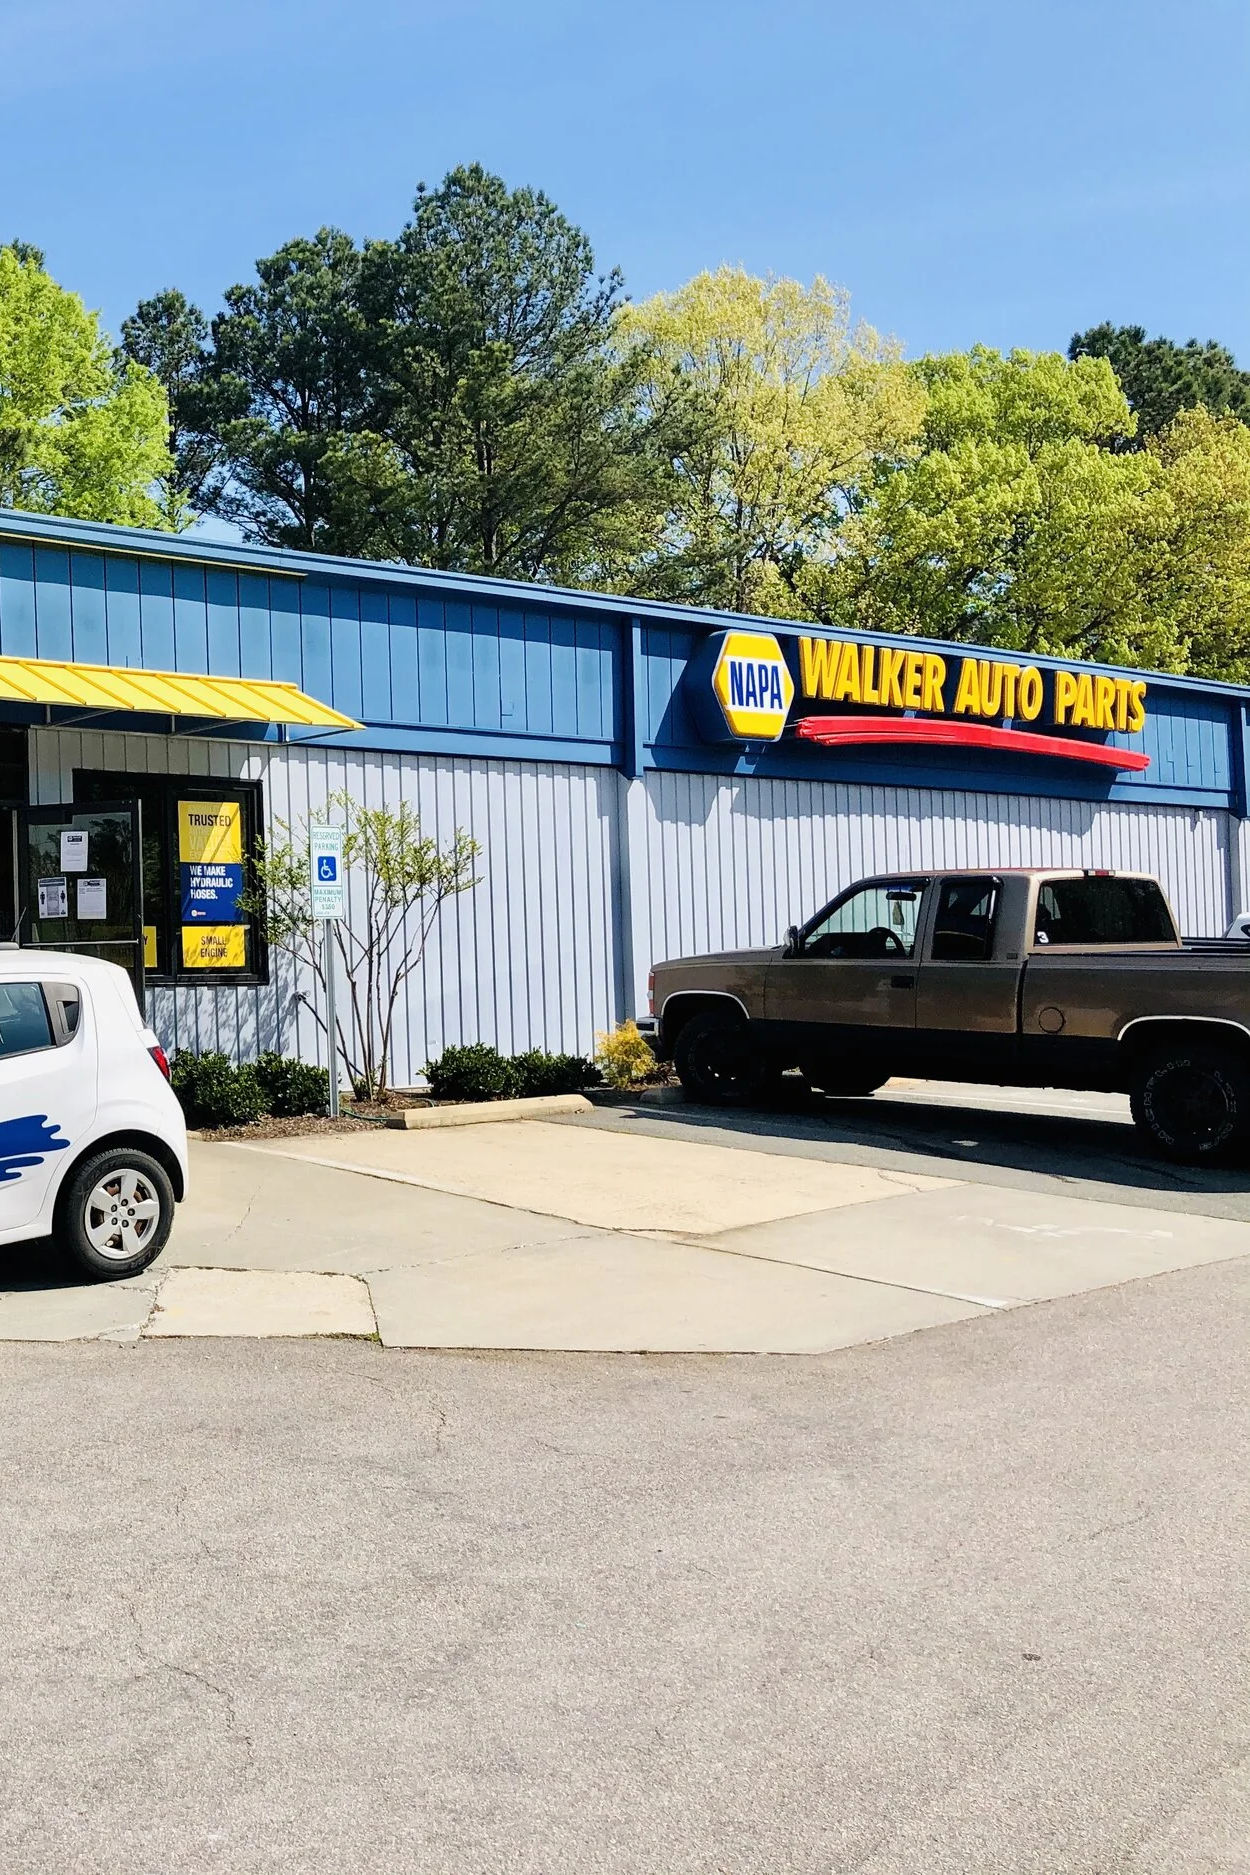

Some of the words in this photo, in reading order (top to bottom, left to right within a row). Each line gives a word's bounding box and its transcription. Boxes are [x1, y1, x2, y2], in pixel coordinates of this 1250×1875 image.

[729, 660, 784, 711] NAPA
[798, 636, 947, 713] WALKER
[955, 657, 1044, 721] AUTO
[1054, 670, 1147, 733] PARTS
[188, 814, 232, 827] TRUSTED
[312, 831, 340, 841] RESERVED
[314, 842, 339, 851] PARKING
[190, 865, 203, 875] WE
[204, 865, 226, 876] MAKE
[190, 877, 234, 888] HYDRAULIC
[190, 889, 218, 899] HOSES.
[314, 888, 342, 896] MAXIMUM
[314, 896, 342, 904] PENALTY
[200, 935, 227, 946] SMALL
[1037, 931, 1049, 943] 3
[200, 947, 227, 958] ENGINE
